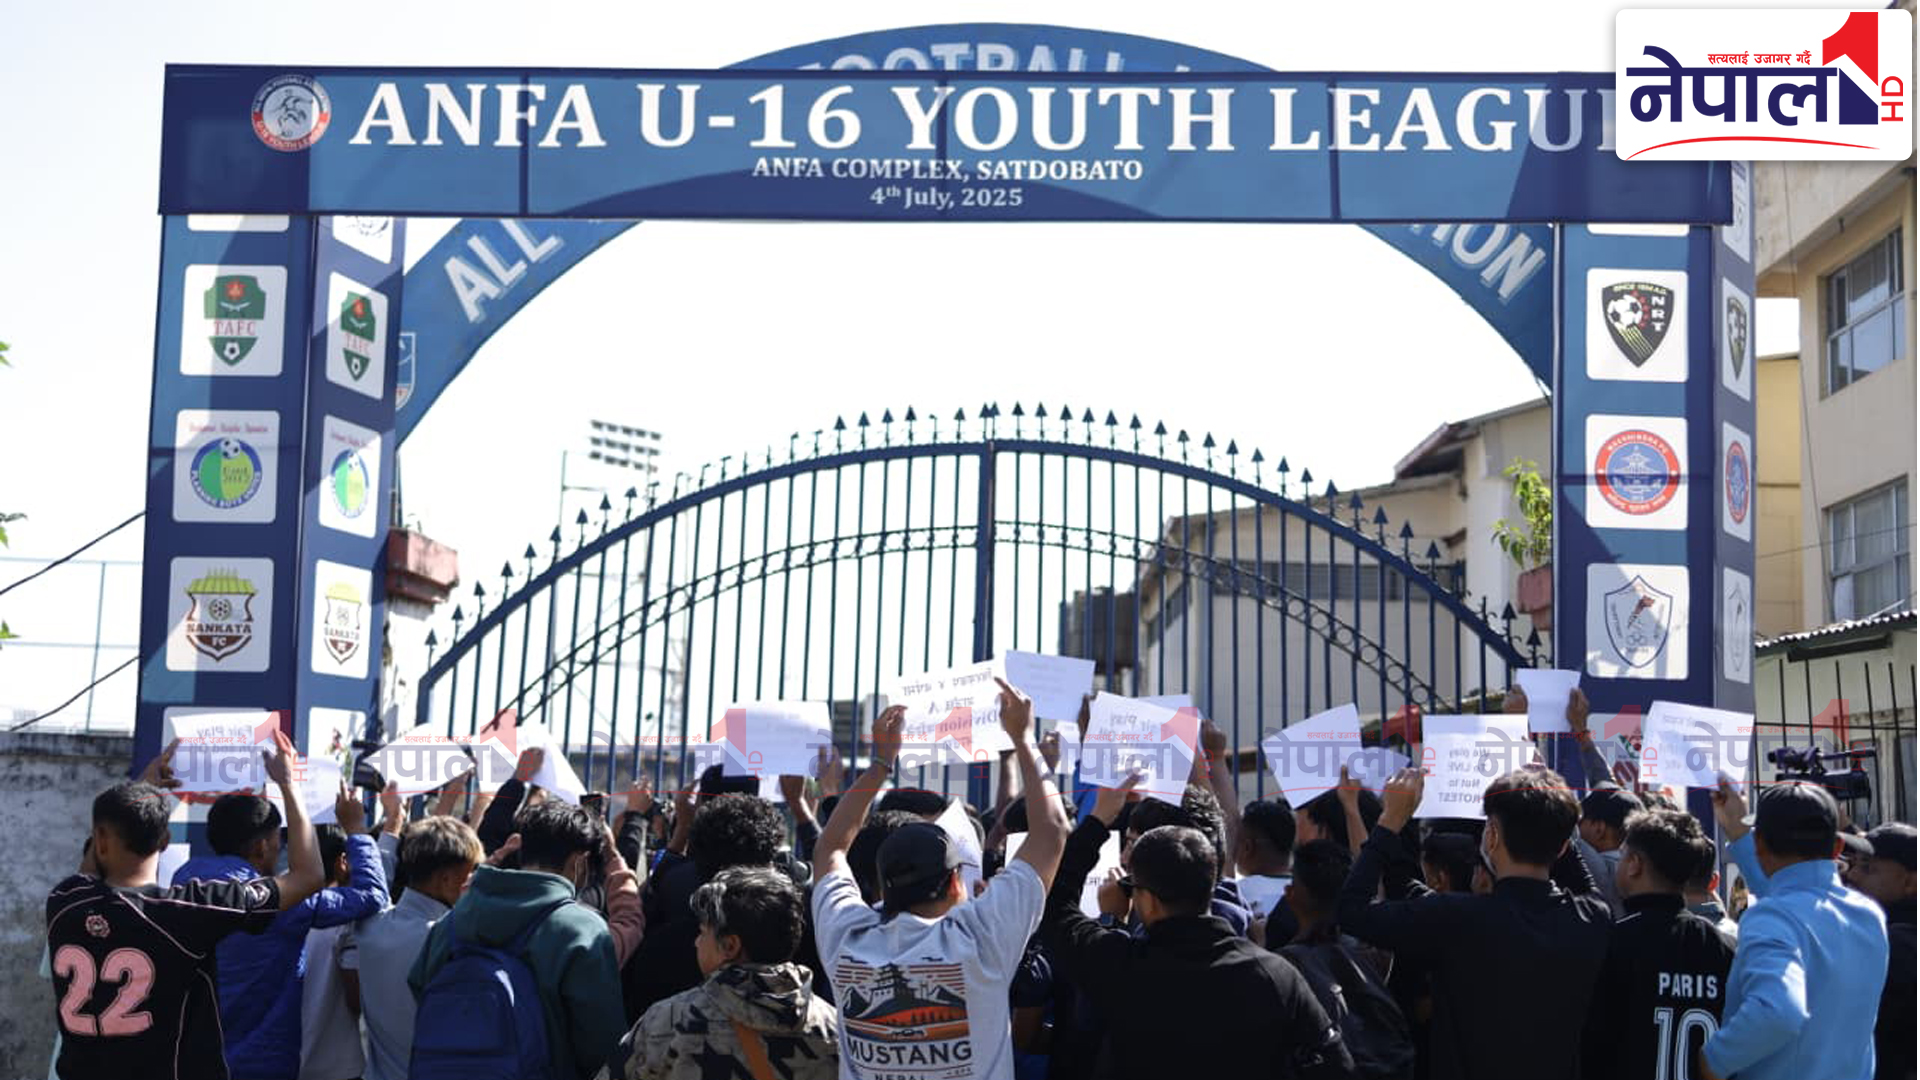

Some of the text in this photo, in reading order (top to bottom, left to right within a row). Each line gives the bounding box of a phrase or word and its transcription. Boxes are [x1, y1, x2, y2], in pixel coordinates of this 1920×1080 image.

[349, 83, 606, 148] ANFA
[636, 83, 862, 149] U-16
[891, 86, 1238, 151] YOUTH
[752, 157, 1143, 183] ANFA COMPLEX, SATDOBATO
[903, 187, 955, 210] July,
[961, 188, 1023, 207] 2025
[444, 217, 562, 323] ALL
[213, 320, 256, 335] TAFC
[186, 623, 252, 634] SANKATA
[212, 636, 227, 647] FC
[52, 944, 155, 1037] 22
[1658, 972, 1718, 998] PARIS
[848, 1040, 972, 1065] MUSTANG
